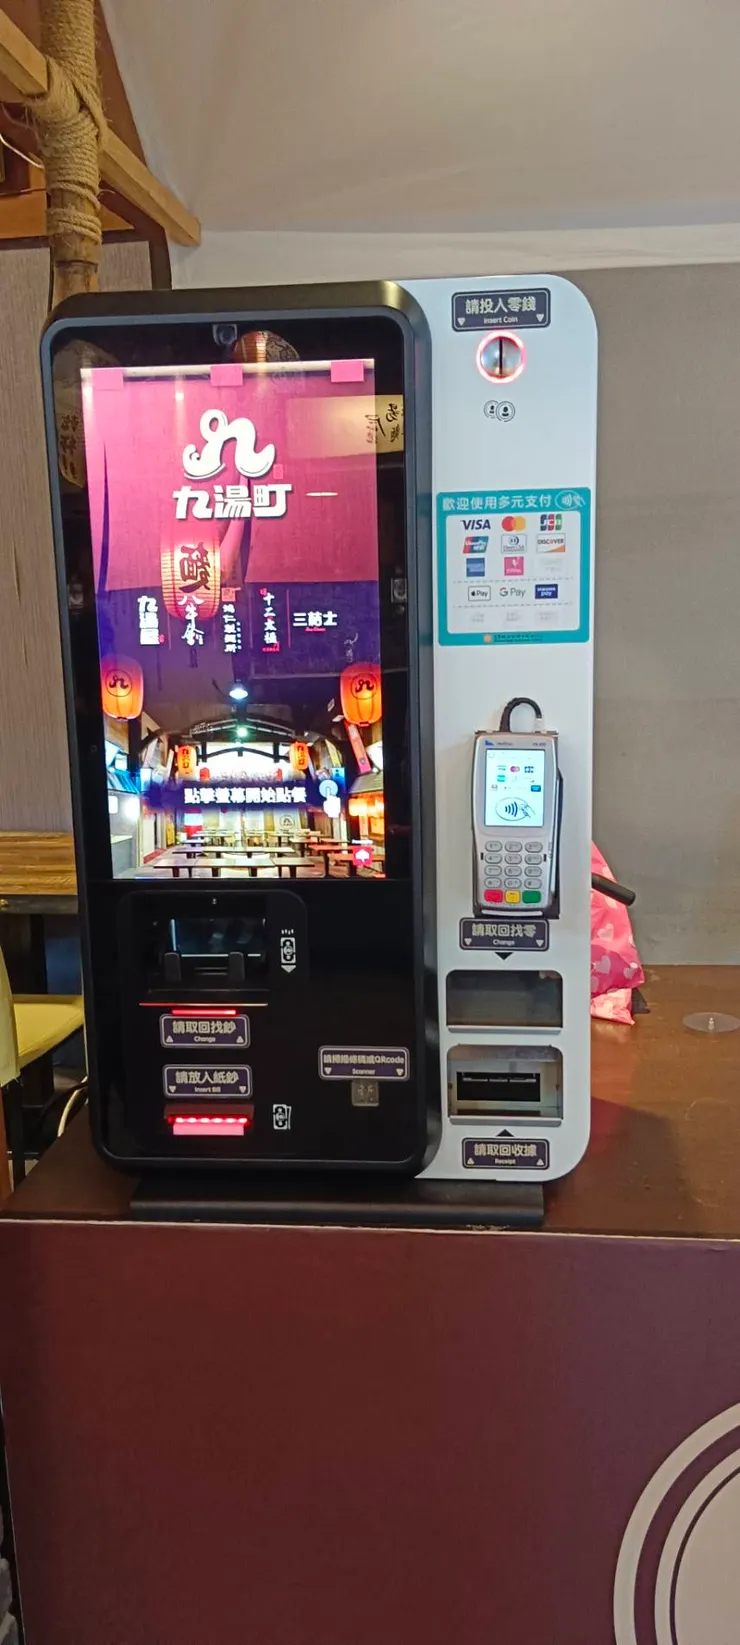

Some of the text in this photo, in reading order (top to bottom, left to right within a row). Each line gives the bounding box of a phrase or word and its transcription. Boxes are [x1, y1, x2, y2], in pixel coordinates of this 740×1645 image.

[465, 296, 536, 315] 請投入零錢
[503, 315, 519, 323] Coin
[172, 484, 293, 520] 九湯町
[442, 494, 553, 511] 歡迎使用多元支付
[461, 519, 491, 531] VISA
[476, 589, 488, 598] Pay
[510, 587, 526, 598] Pay
[472, 923, 536, 937] 請取回找零
[172, 1021, 237, 1034] 請取回找鈔
[193, 1035, 216, 1043] Change
[175, 1071, 239, 1084] 請放入紙鈔
[474, 1143, 537, 1157] 請取回收據
